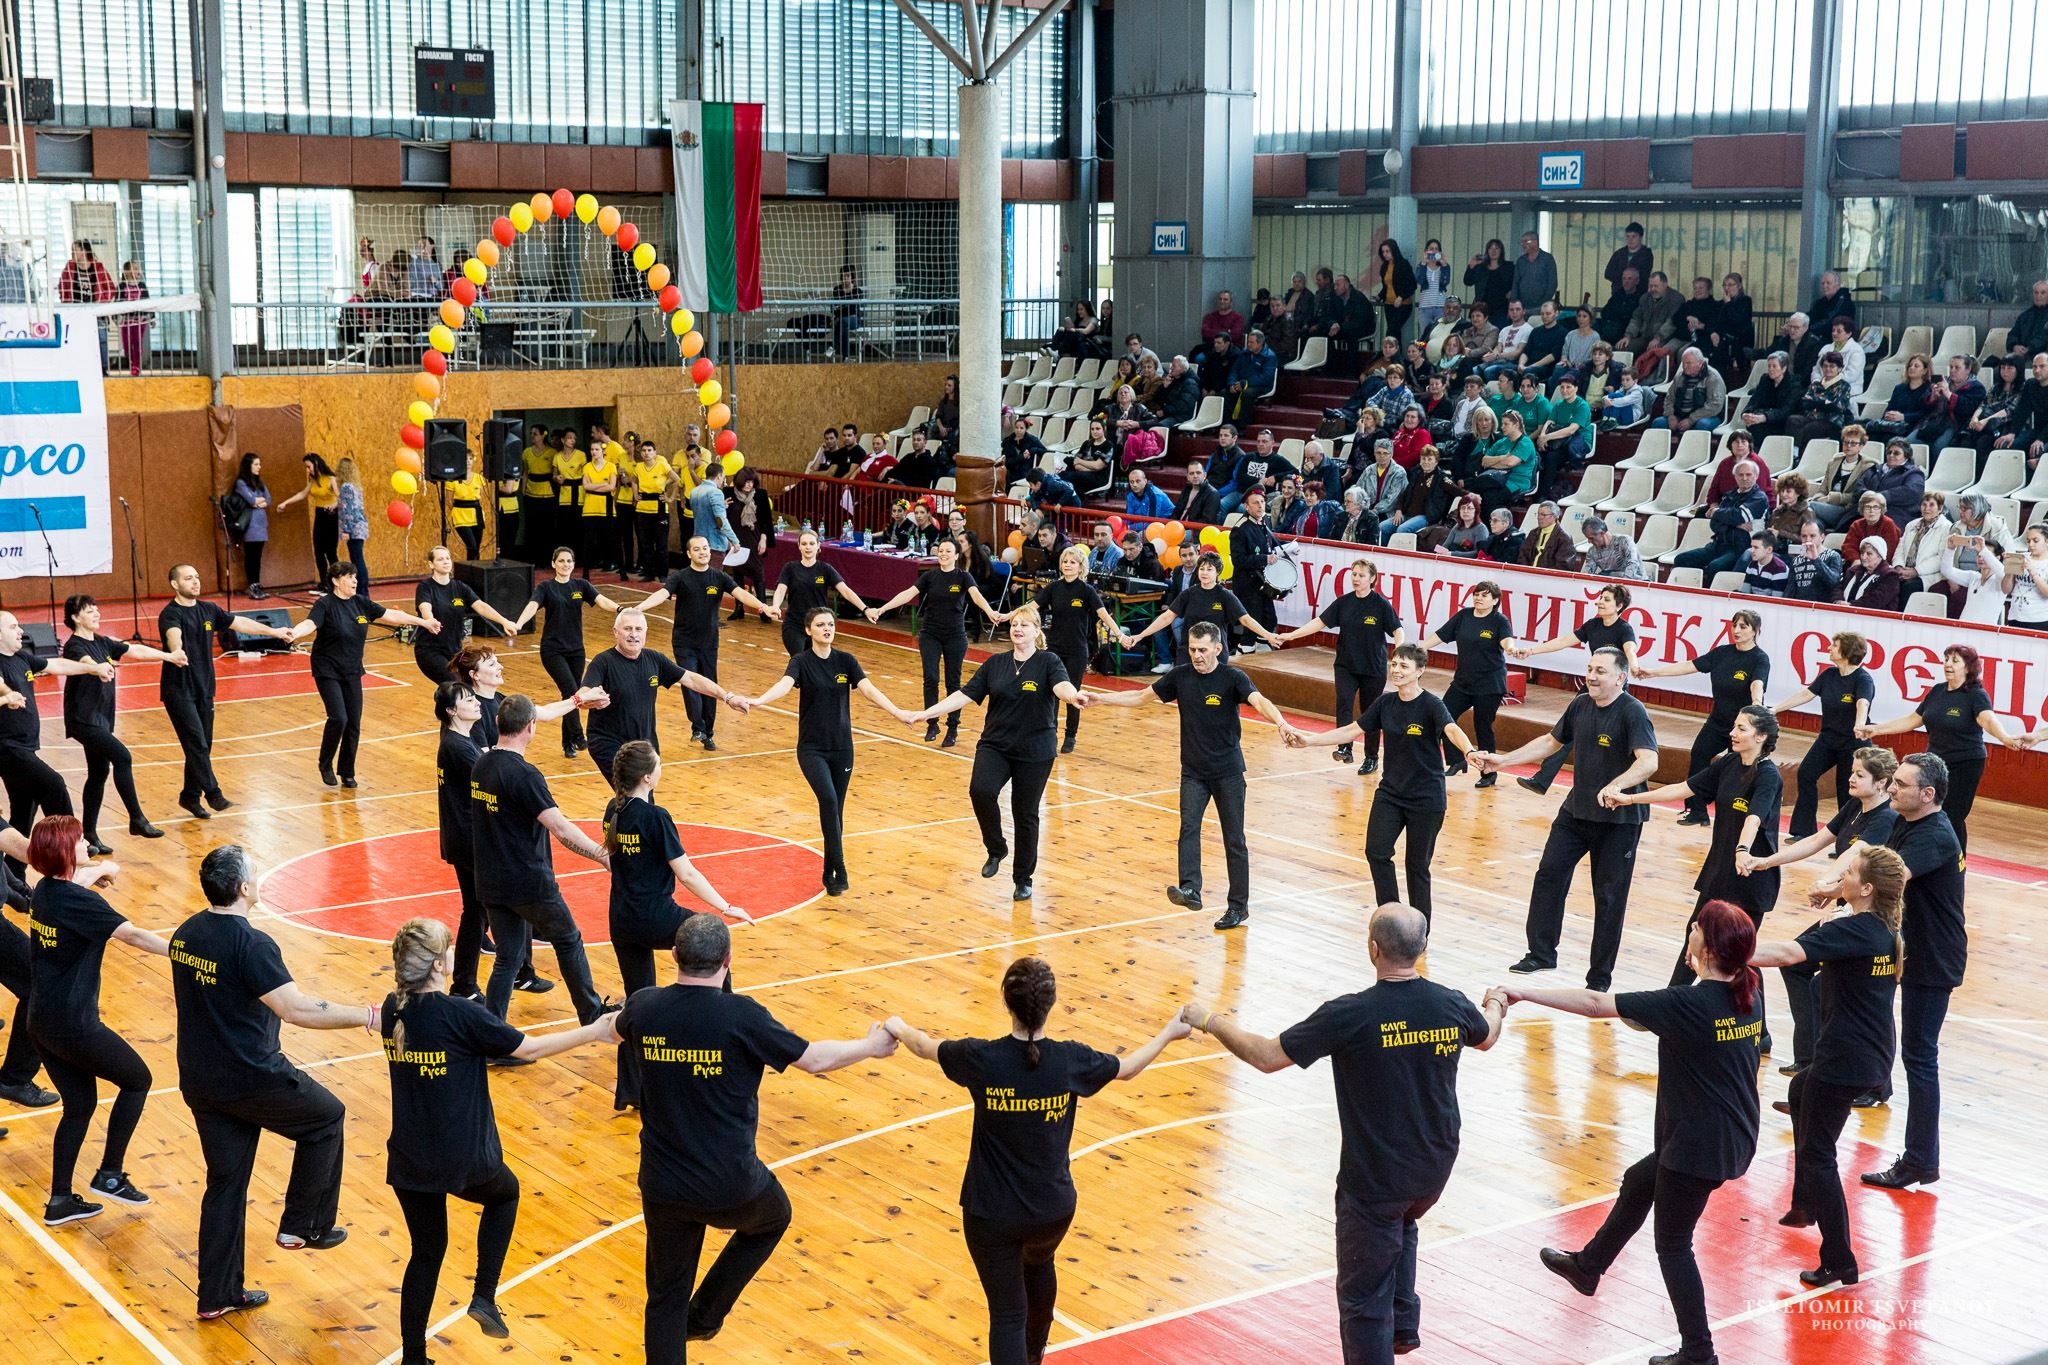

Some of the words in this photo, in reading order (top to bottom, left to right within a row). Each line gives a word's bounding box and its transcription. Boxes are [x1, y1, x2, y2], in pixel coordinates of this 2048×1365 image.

[417, 50, 453, 61] ДОМАКИНИ
[464, 52, 485, 62] ГОСТИ
[622, 844, 641, 856] Русе
[195, 970, 217, 986] Русе
[1381, 1026, 1459, 1048] НАШЕНЦИ
[643, 1047, 723, 1065] НАШЕНЦИ
[1434, 1043, 1458, 1057] Русе
[420, 1065, 448, 1080] Русе
[693, 1063, 723, 1079] Русе
